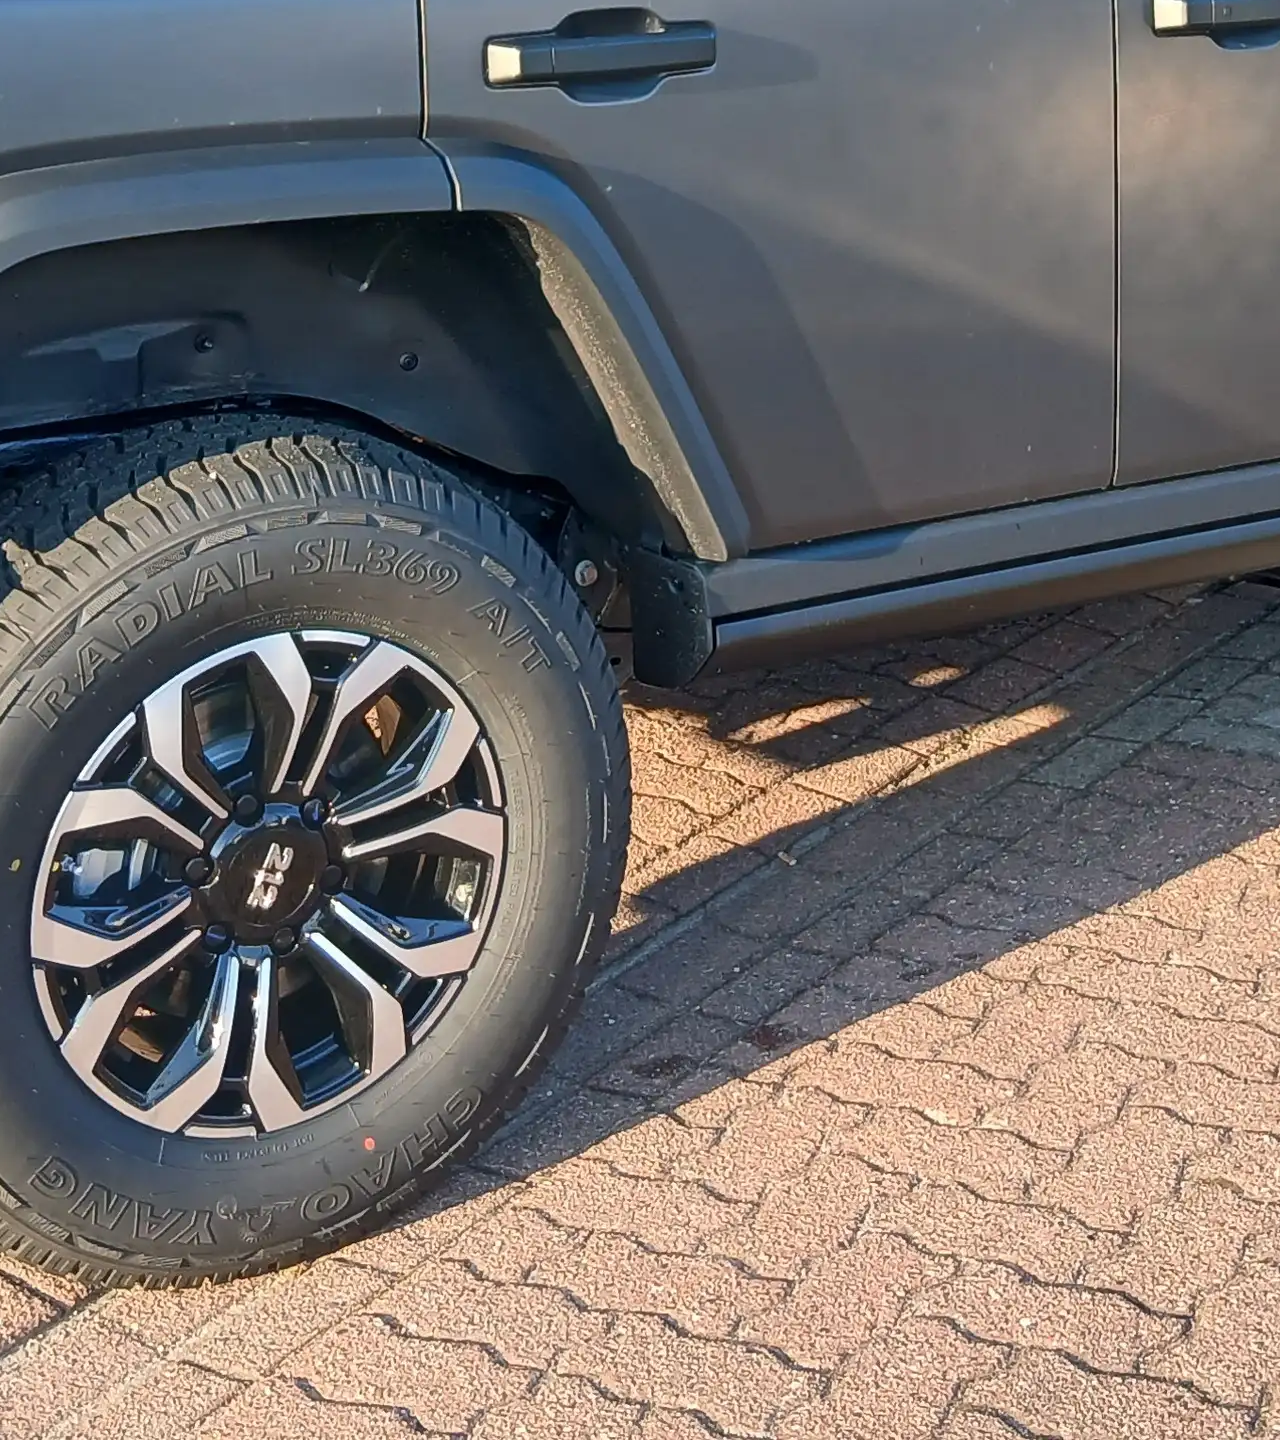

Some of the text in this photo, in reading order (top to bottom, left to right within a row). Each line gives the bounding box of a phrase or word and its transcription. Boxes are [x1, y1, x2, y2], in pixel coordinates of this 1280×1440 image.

[26, 548, 274, 732] RADIAL
[290, 537, 461, 596] SL369
[246, 842, 295, 910] 212
[27, 1154, 218, 1246] YANG
[300, 1085, 483, 1224] CHAO
